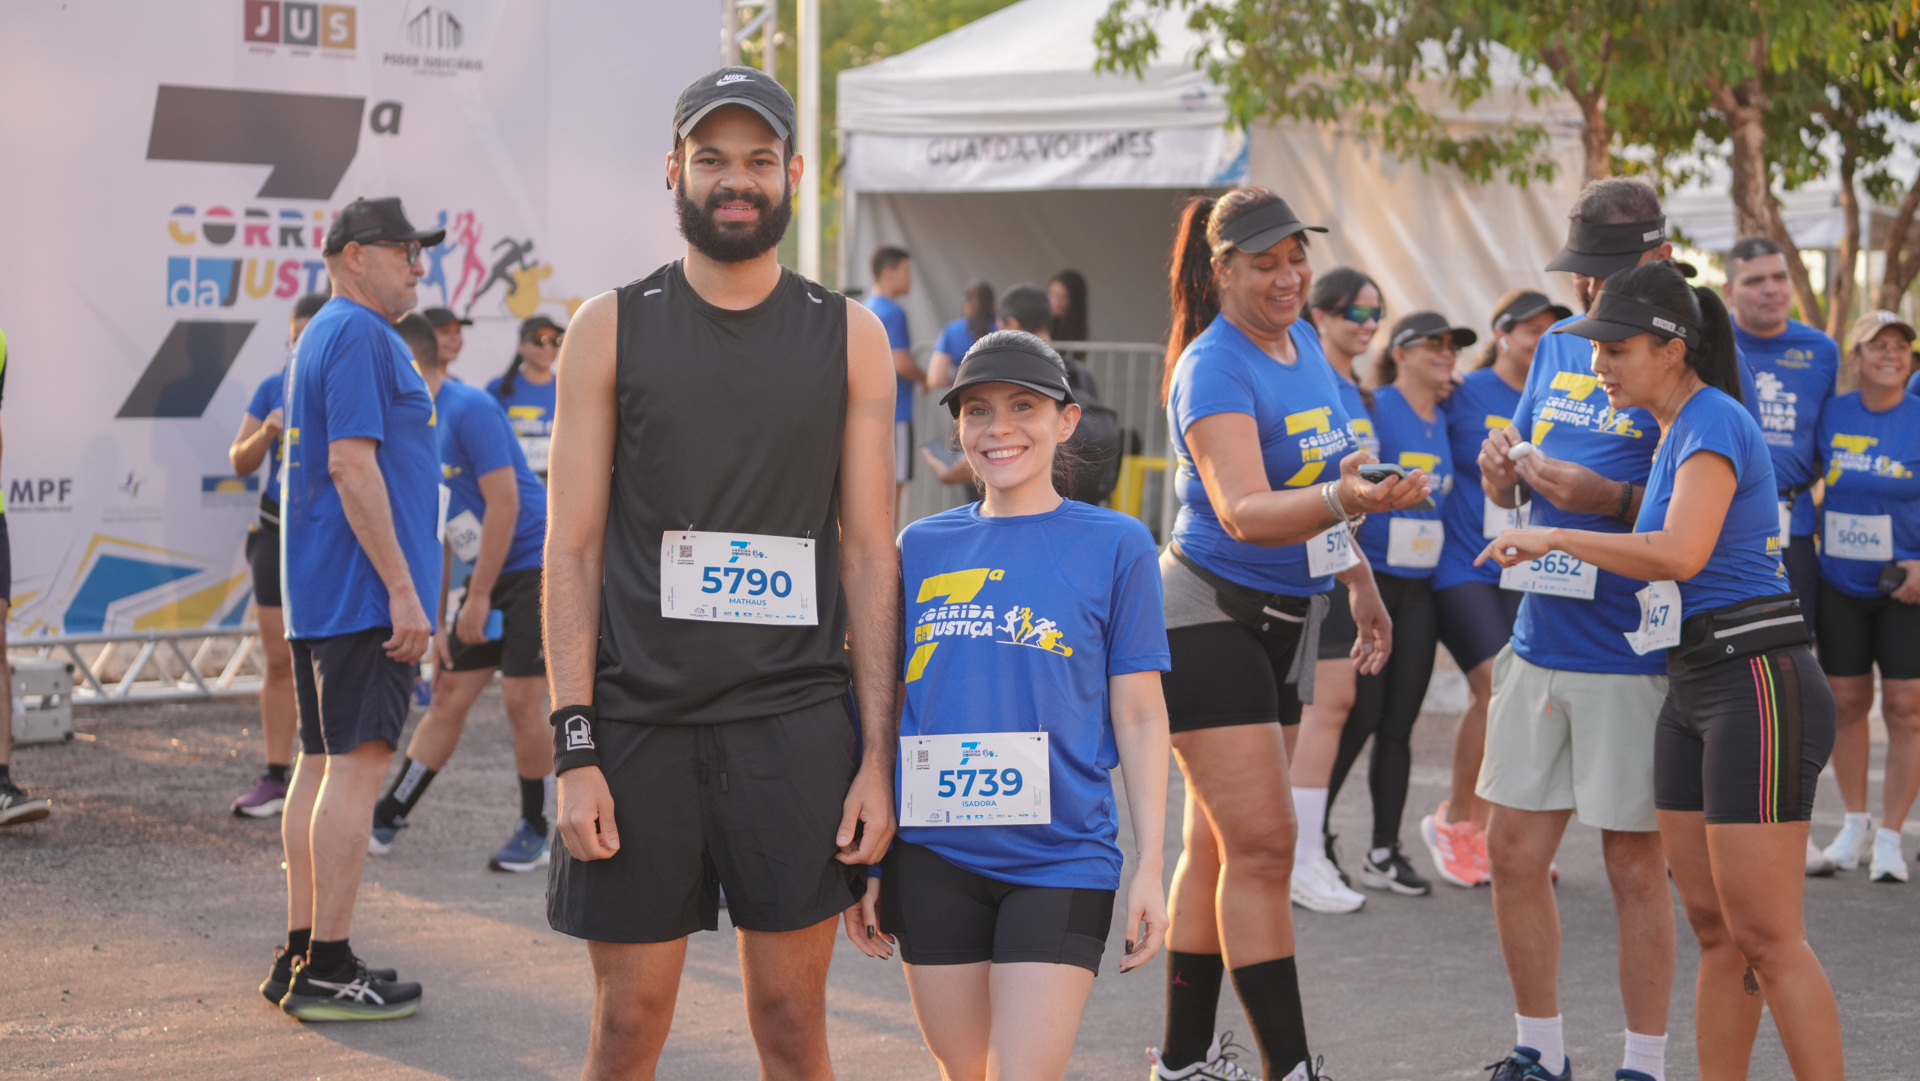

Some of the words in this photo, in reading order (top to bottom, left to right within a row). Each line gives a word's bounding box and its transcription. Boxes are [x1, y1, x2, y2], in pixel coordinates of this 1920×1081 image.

[250, 3, 352, 45] JUS
[927, 131, 1156, 165] GUARDA-VOLUMES
[168, 205, 341, 247] CORRI
[222, 259, 328, 307] JUST
[1546, 396, 1595, 415] CORRIDA
[1550, 410, 1591, 427] JUSTIÇA
[1299, 428, 1345, 449] CORRIDA
[1319, 438, 1348, 460] JUSTIÇA
[9, 479, 72, 503] MPF
[1326, 530, 1348, 553] 570
[1838, 530, 1880, 545] 5004
[1530, 554, 1582, 576] 5652
[701, 566, 792, 598] 5790
[729, 598, 767, 606] MATHAUS
[918, 604, 995, 625] CORRIDA
[1647, 605, 1670, 629] 47
[927, 620, 994, 641] JUSTIÇA
[938, 768, 1023, 798] 5739
